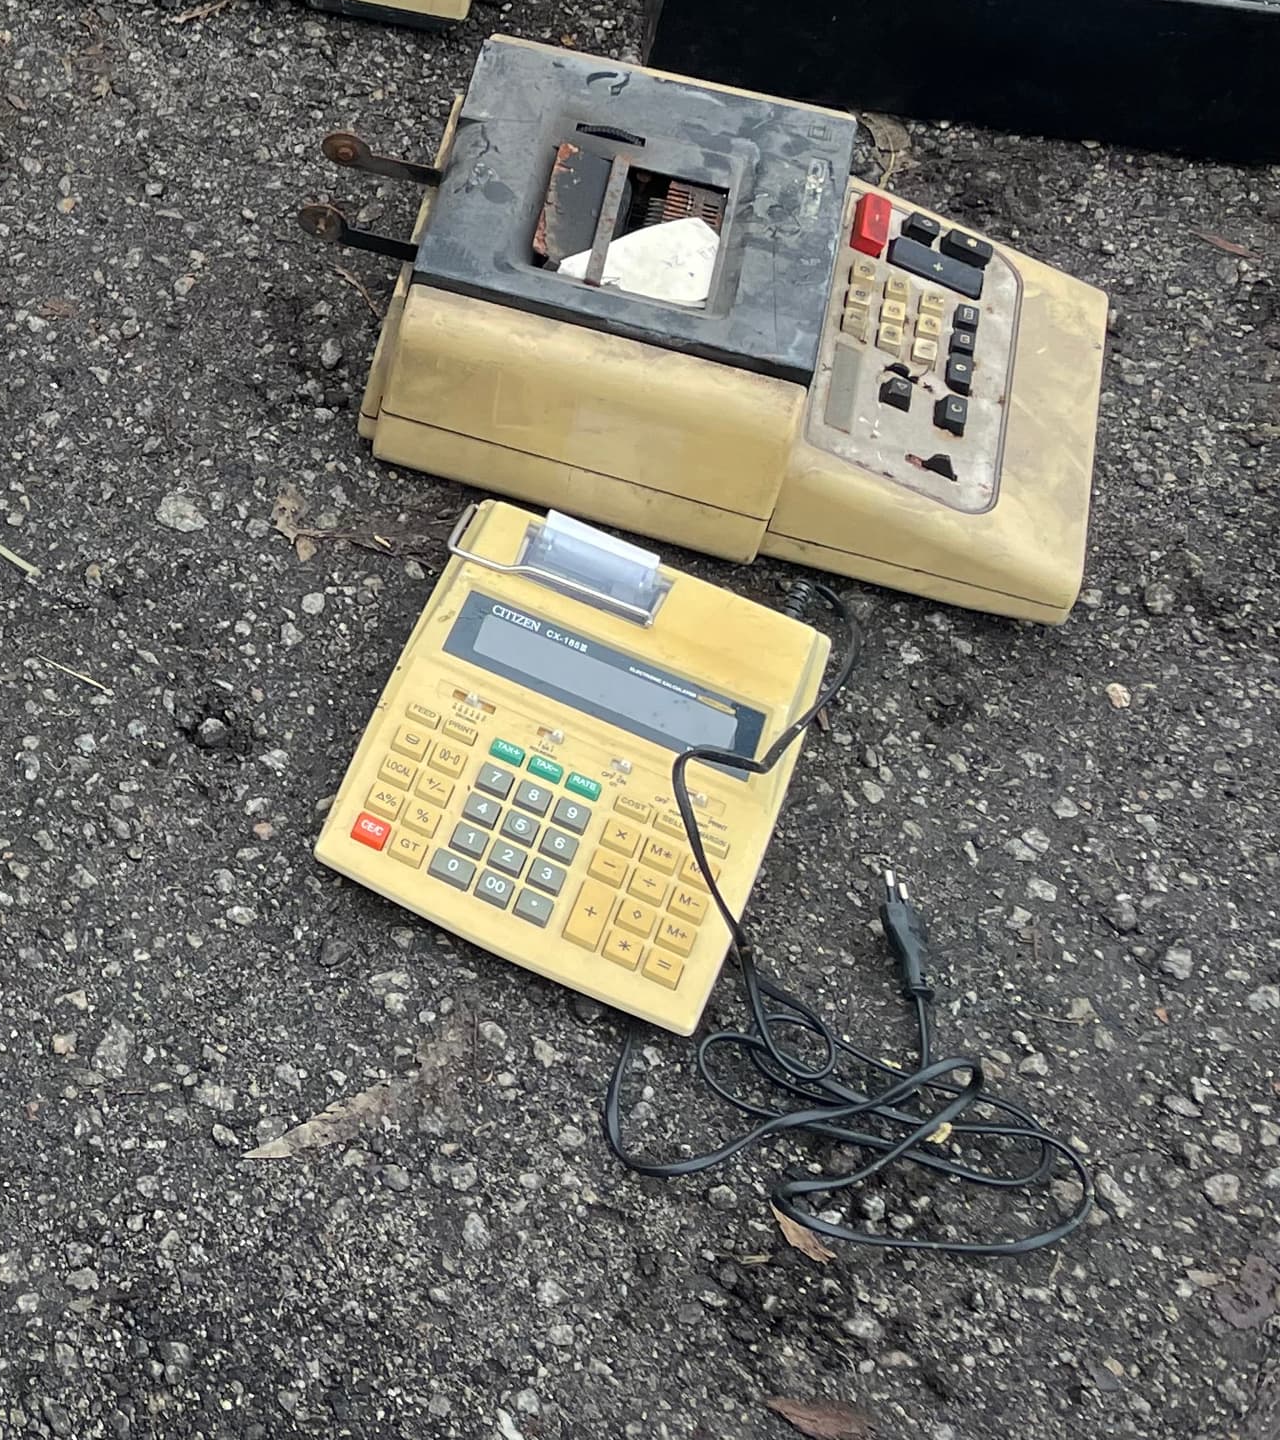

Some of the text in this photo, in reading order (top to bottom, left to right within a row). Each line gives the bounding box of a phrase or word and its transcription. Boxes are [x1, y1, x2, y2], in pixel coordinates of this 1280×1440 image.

[492, 603, 541, 633] CITIZEN
[413, 703, 438, 719] FEED
[448, 719, 476, 736] PRINT
[385, 758, 411, 778] LOCAL
[496, 740, 521, 756] TAX+
[571, 774, 598, 791] RATE
[620, 796, 647, 811] COST
[360, 818, 385, 837] CE/C
[400, 837, 421, 852] GT
[485, 875, 507, 894] 00
[666, 924, 688, 939] M+
